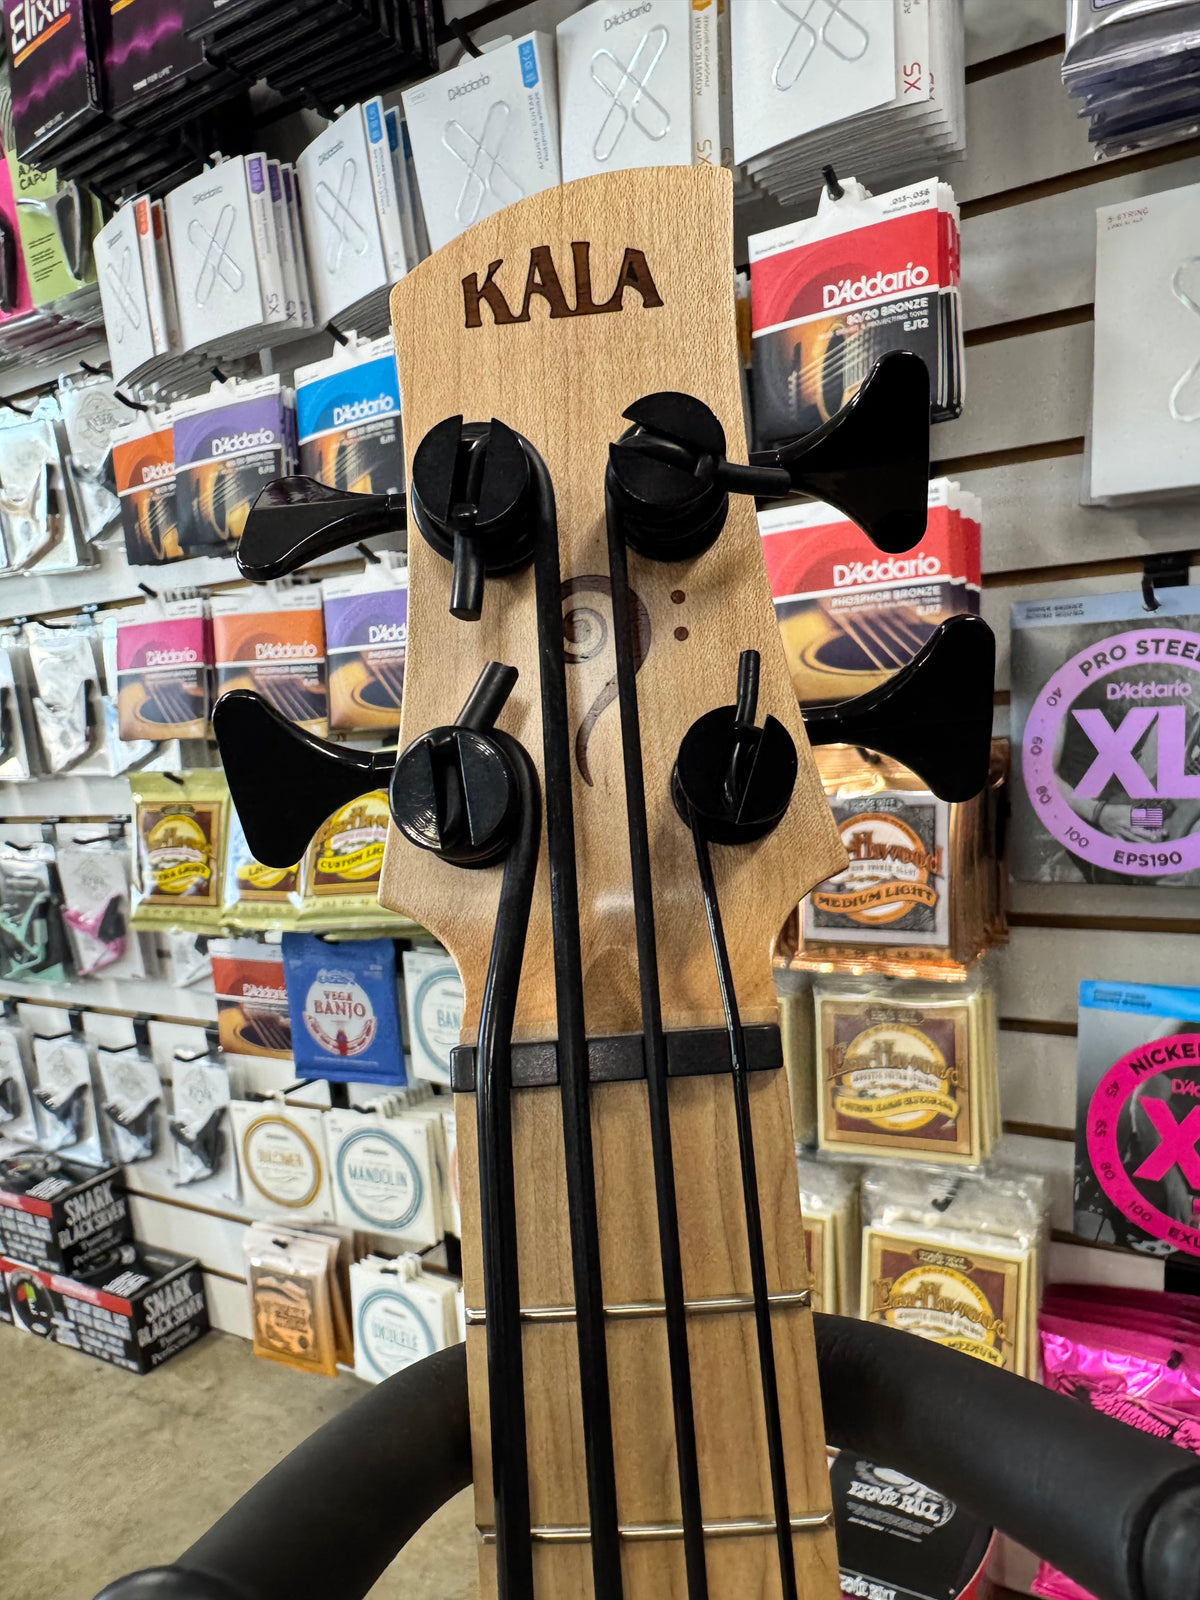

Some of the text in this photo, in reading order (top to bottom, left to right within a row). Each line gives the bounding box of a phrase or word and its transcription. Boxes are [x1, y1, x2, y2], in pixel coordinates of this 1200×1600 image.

[902, 62, 922, 94] XS
[461, 241, 665, 329] KALA
[822, 261, 930, 309] D'Addario
[880, 296, 929, 317] BRONZE
[903, 317, 930, 332] EJ12
[333, 391, 395, 426] D'Addario
[211, 427, 275, 457] D'Addario
[832, 551, 942, 587] D'Addario
[1078, 644, 1127, 678] PRO
[1106, 679, 1192, 701] D'Addario
[1071, 705, 1200, 799] XL
[1063, 825, 1090, 850] 100
[1113, 849, 1183, 869] EPS190
[817, 884, 934, 909] MEDIUM LIGHT
[323, 990, 354, 1002] VEGA
[313, 999, 367, 1020] BANJO
[436, 1010, 462, 1029] BAN
[1128, 1043, 1200, 1076] NICKE
[347, 1163, 409, 1188] MANDOLIN
[1127, 1199, 1153, 1223] 100
